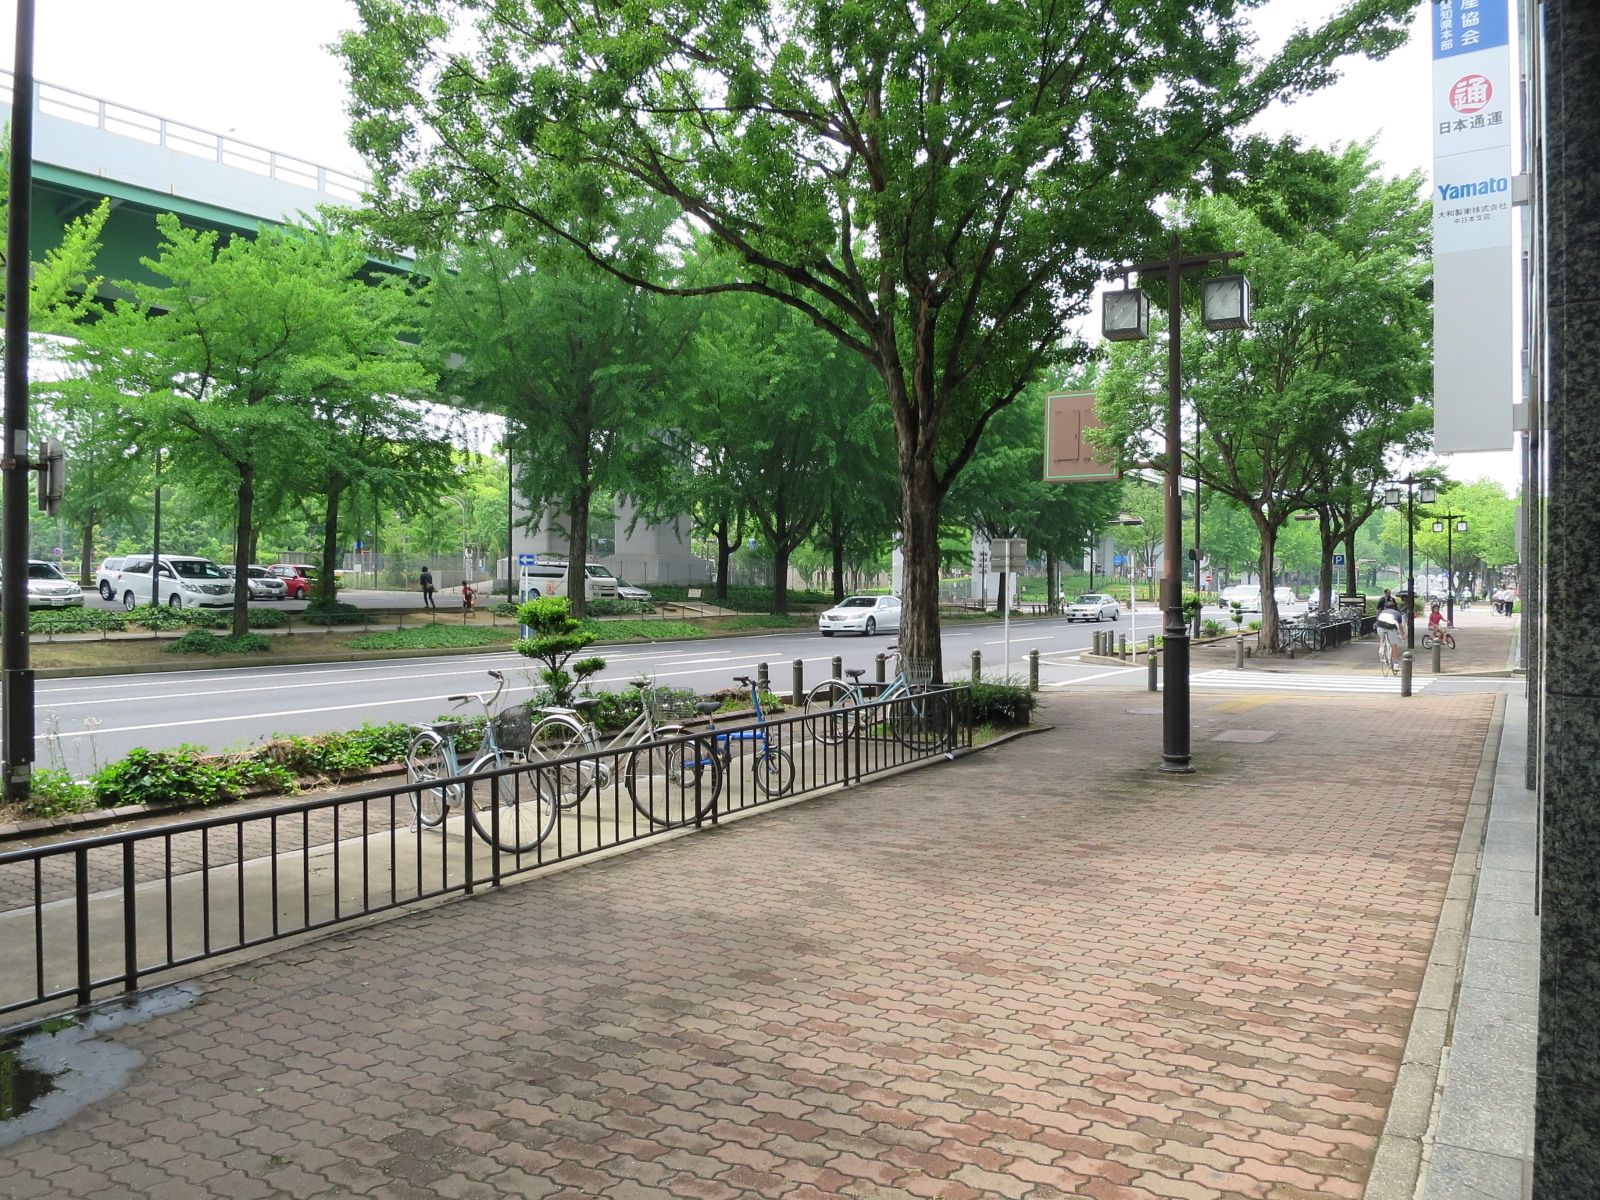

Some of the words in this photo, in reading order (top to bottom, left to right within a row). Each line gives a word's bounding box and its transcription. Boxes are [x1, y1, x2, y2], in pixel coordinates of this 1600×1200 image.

[1440, 111, 1503, 135] 日本通運
[1437, 177, 1508, 201] Yamato
[1335, 555, 1343, 565] P
